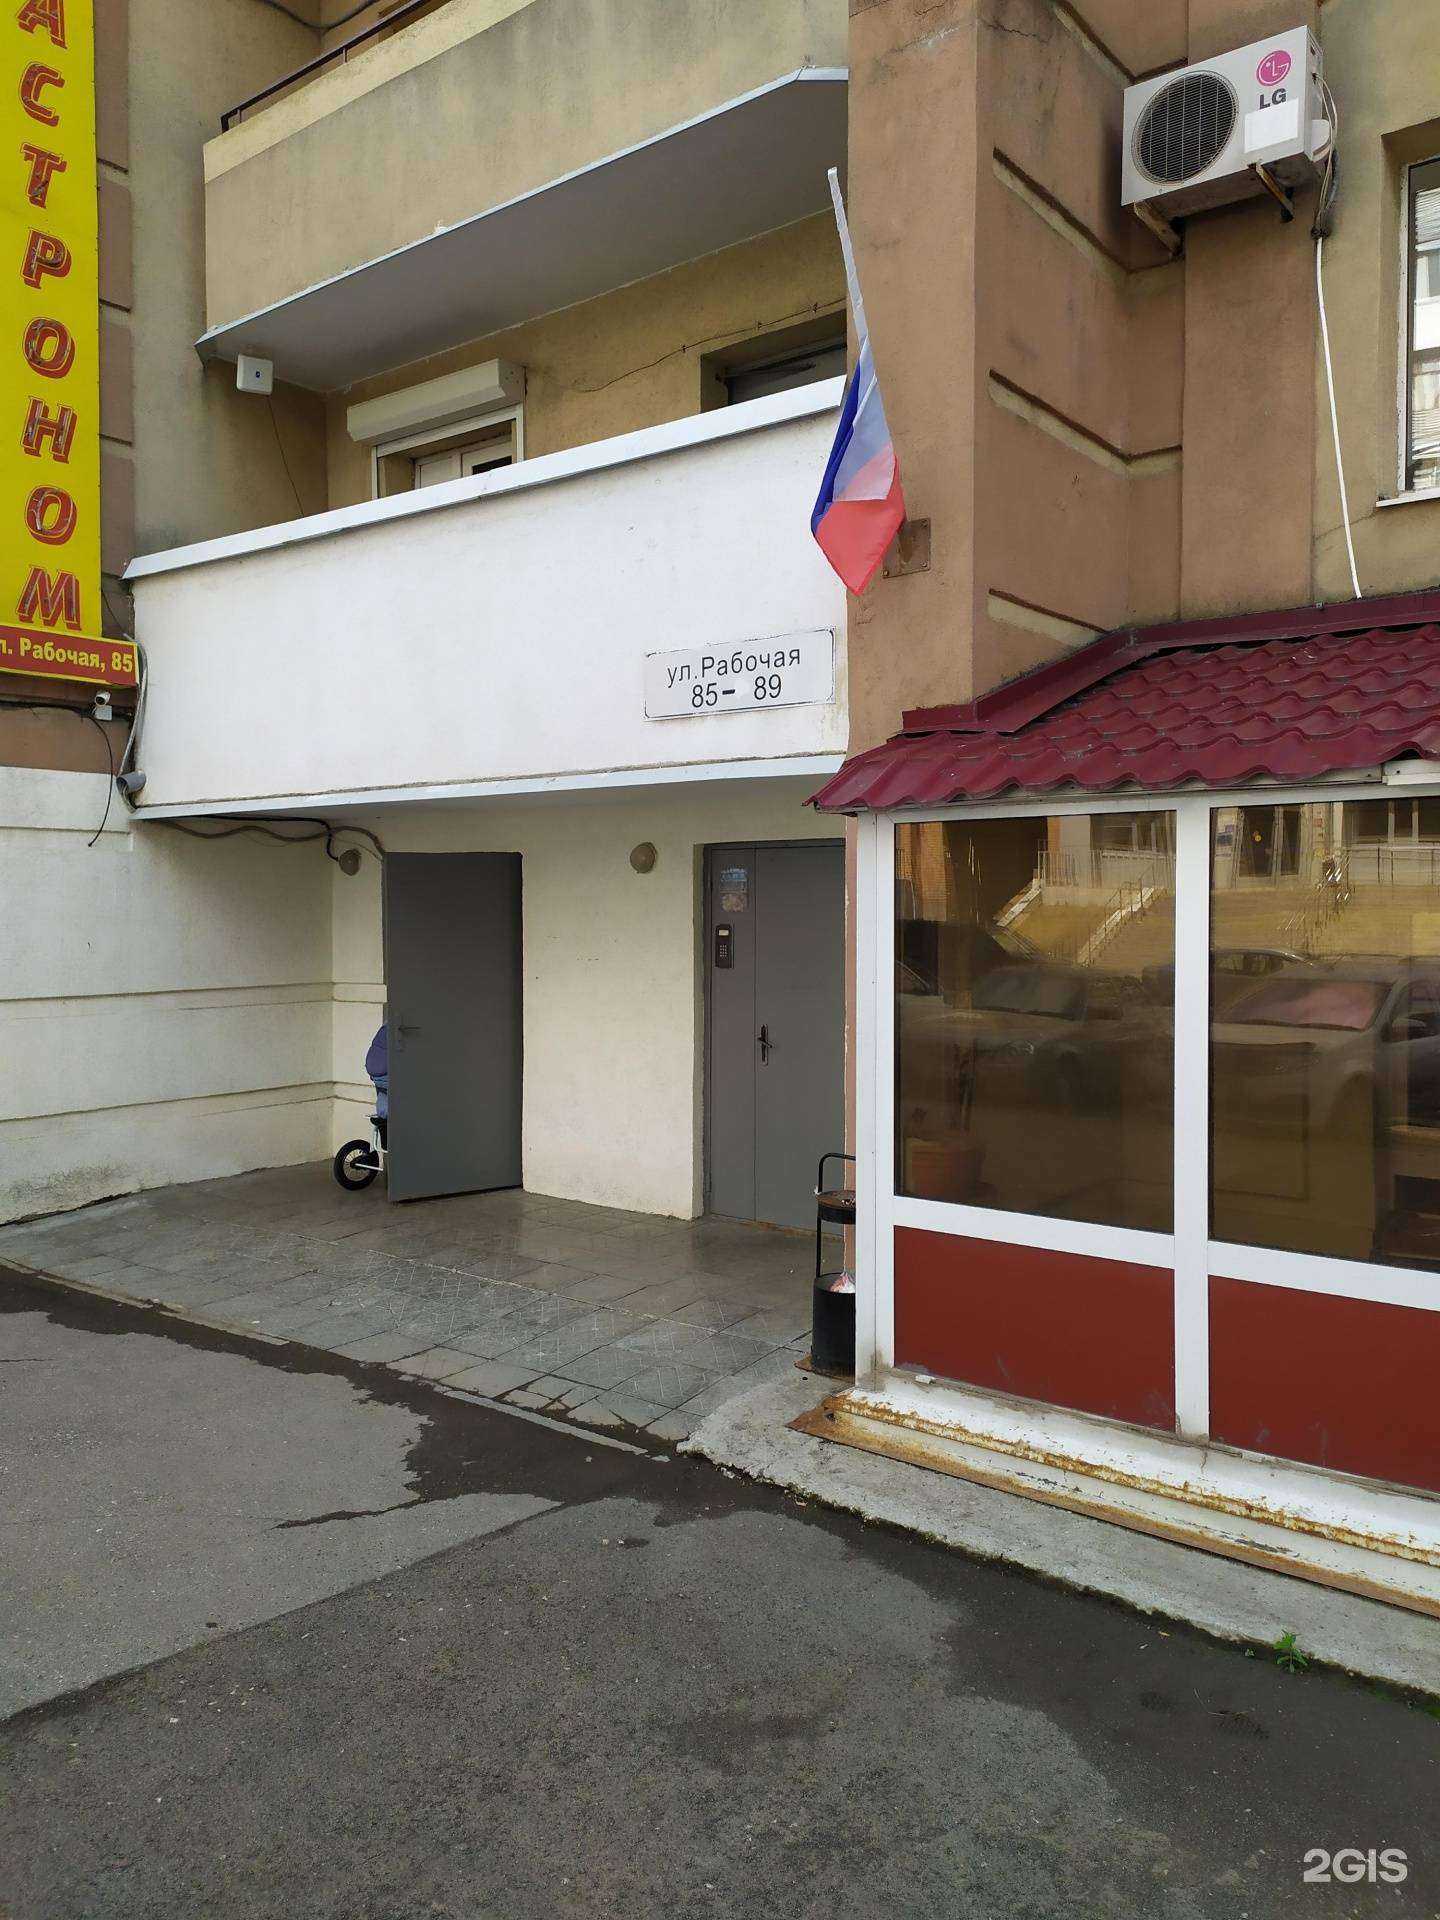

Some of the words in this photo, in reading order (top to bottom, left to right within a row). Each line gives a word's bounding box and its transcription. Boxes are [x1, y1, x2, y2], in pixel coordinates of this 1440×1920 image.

[1259, 87, 1287, 110] LG
[19, 637, 106, 673] Рабочая,
[111, 652, 133, 673] 85
[754, 674, 782, 701] 89
